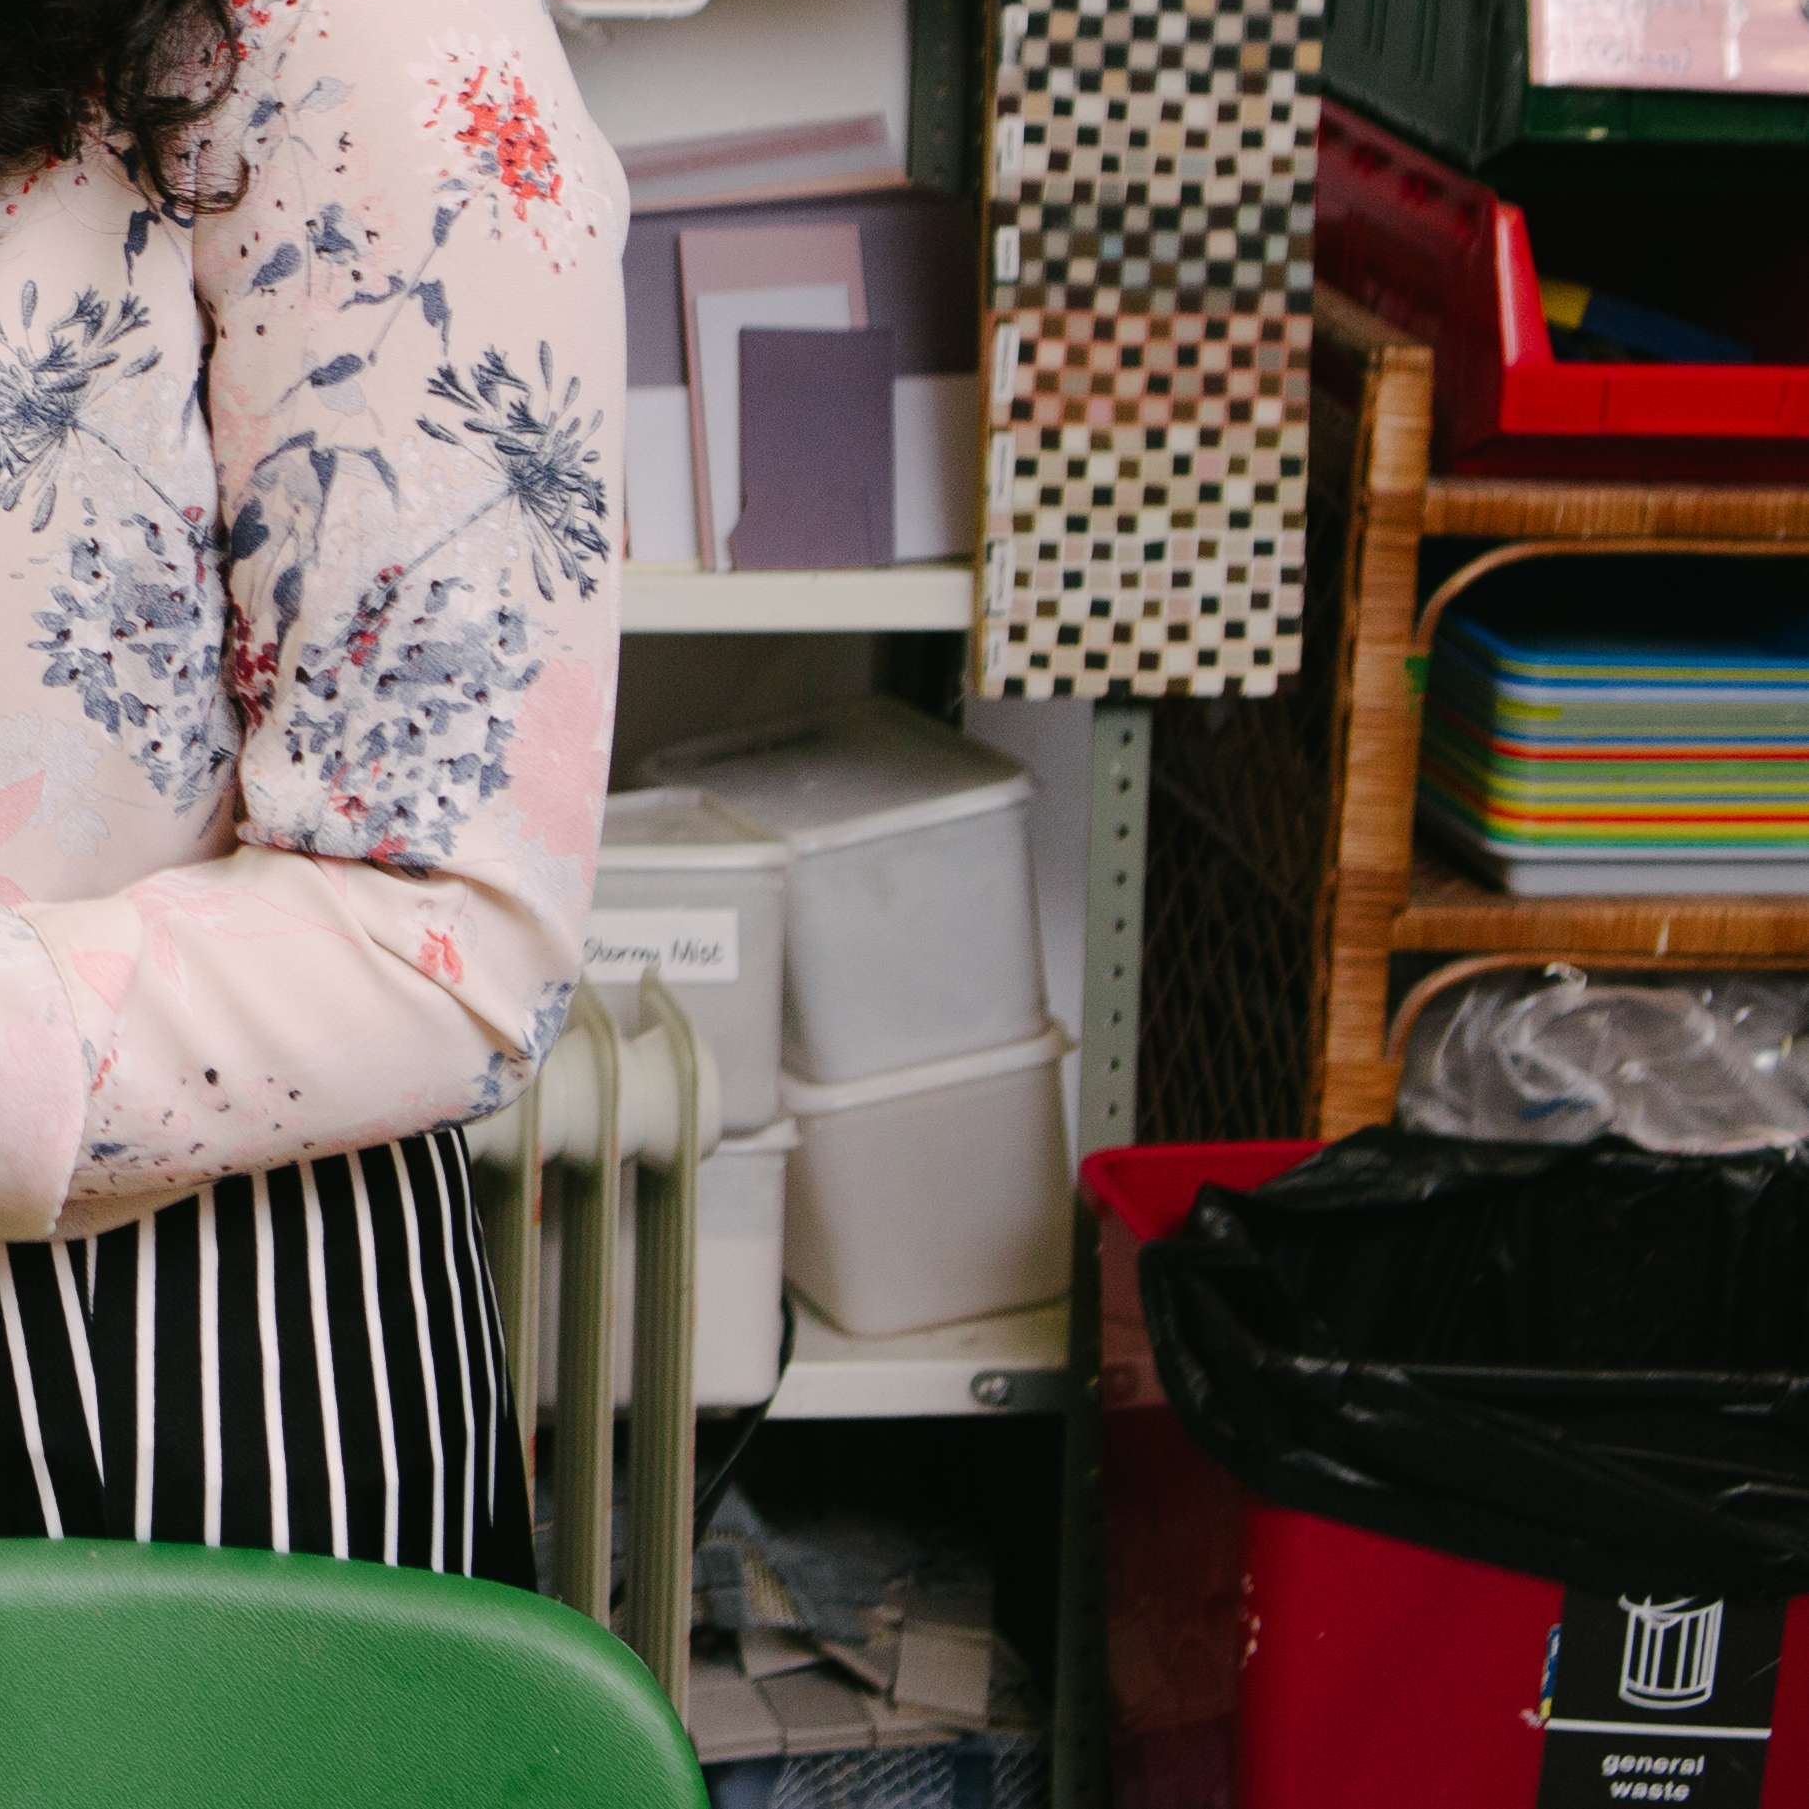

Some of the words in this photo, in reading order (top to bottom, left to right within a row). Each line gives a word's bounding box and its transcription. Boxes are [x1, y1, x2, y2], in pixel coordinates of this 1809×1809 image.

[670, 938, 725, 966] Mist
[1601, 1753, 1705, 1777] general
[1609, 1780, 1691, 1803] waste
